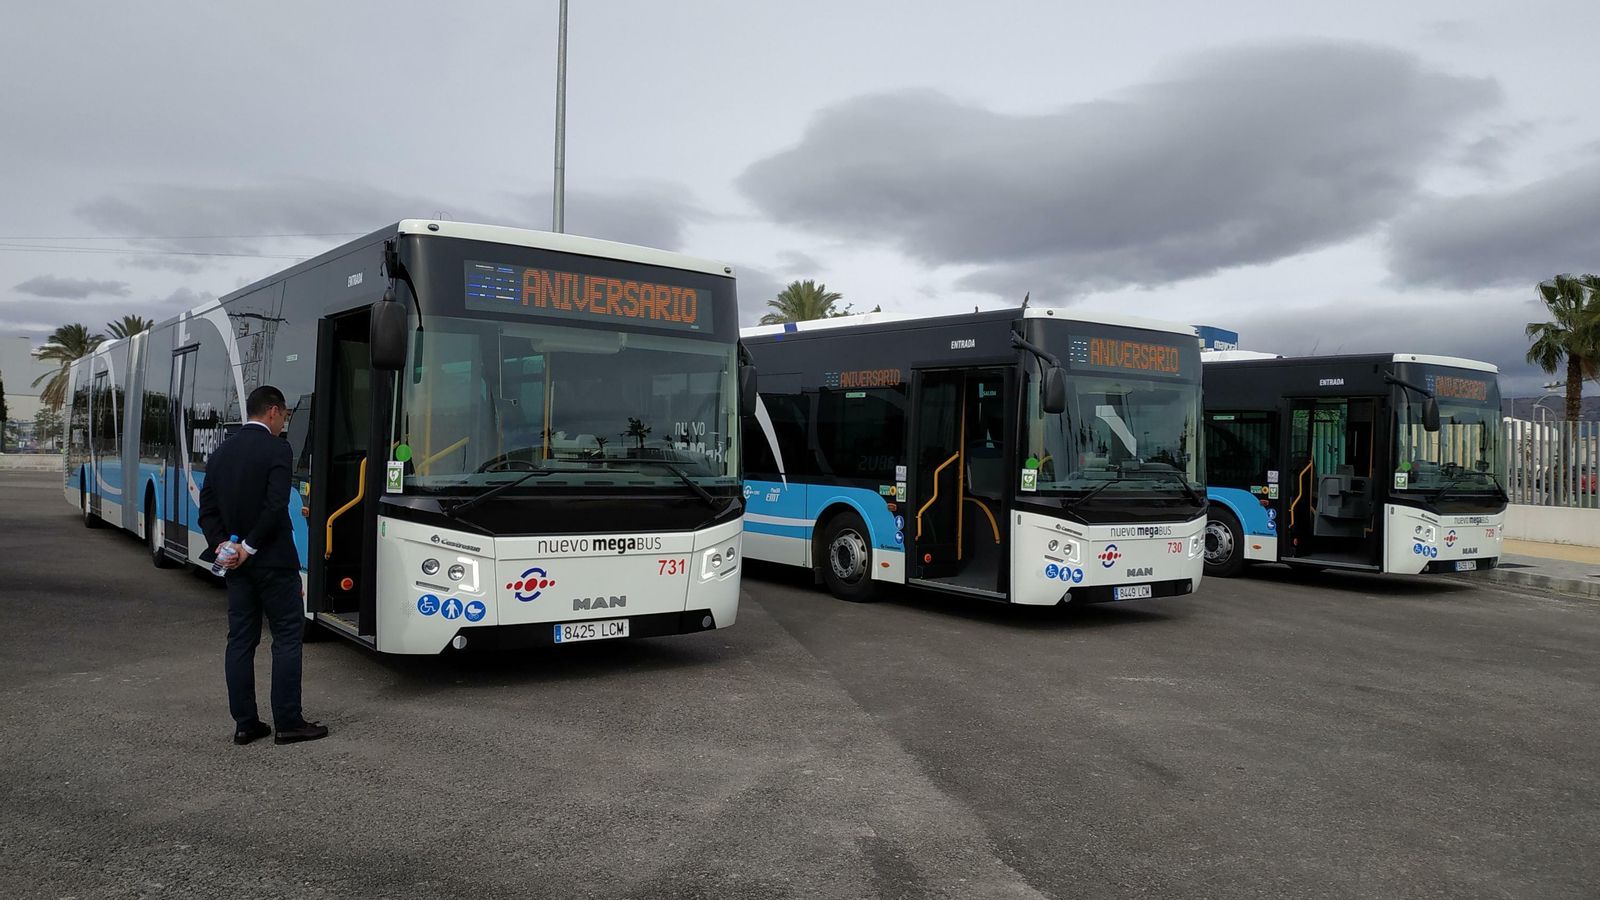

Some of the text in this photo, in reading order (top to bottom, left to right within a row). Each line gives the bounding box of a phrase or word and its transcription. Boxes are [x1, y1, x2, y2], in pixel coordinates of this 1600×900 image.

[522, 268, 697, 324] ANIVERSARIO
[951, 338, 976, 350] ENTRADA
[1089, 338, 1180, 373] ANIVERSARIO
[839, 368, 901, 388] ANIVERSARIO
[1319, 378, 1345, 386] ENTRADA
[1110, 525, 1173, 539] nuevo megaBUS
[538, 536, 662, 555] nuevo megaBUS
[1167, 541, 1182, 554] 730
[1462, 547, 1478, 555] MAN
[658, 558, 686, 576] 731
[1126, 567, 1153, 578] MAN
[1118, 585, 1151, 598] 8449 LCM
[572, 595, 628, 611] MAN
[564, 621, 625, 640] 8425 LCM
